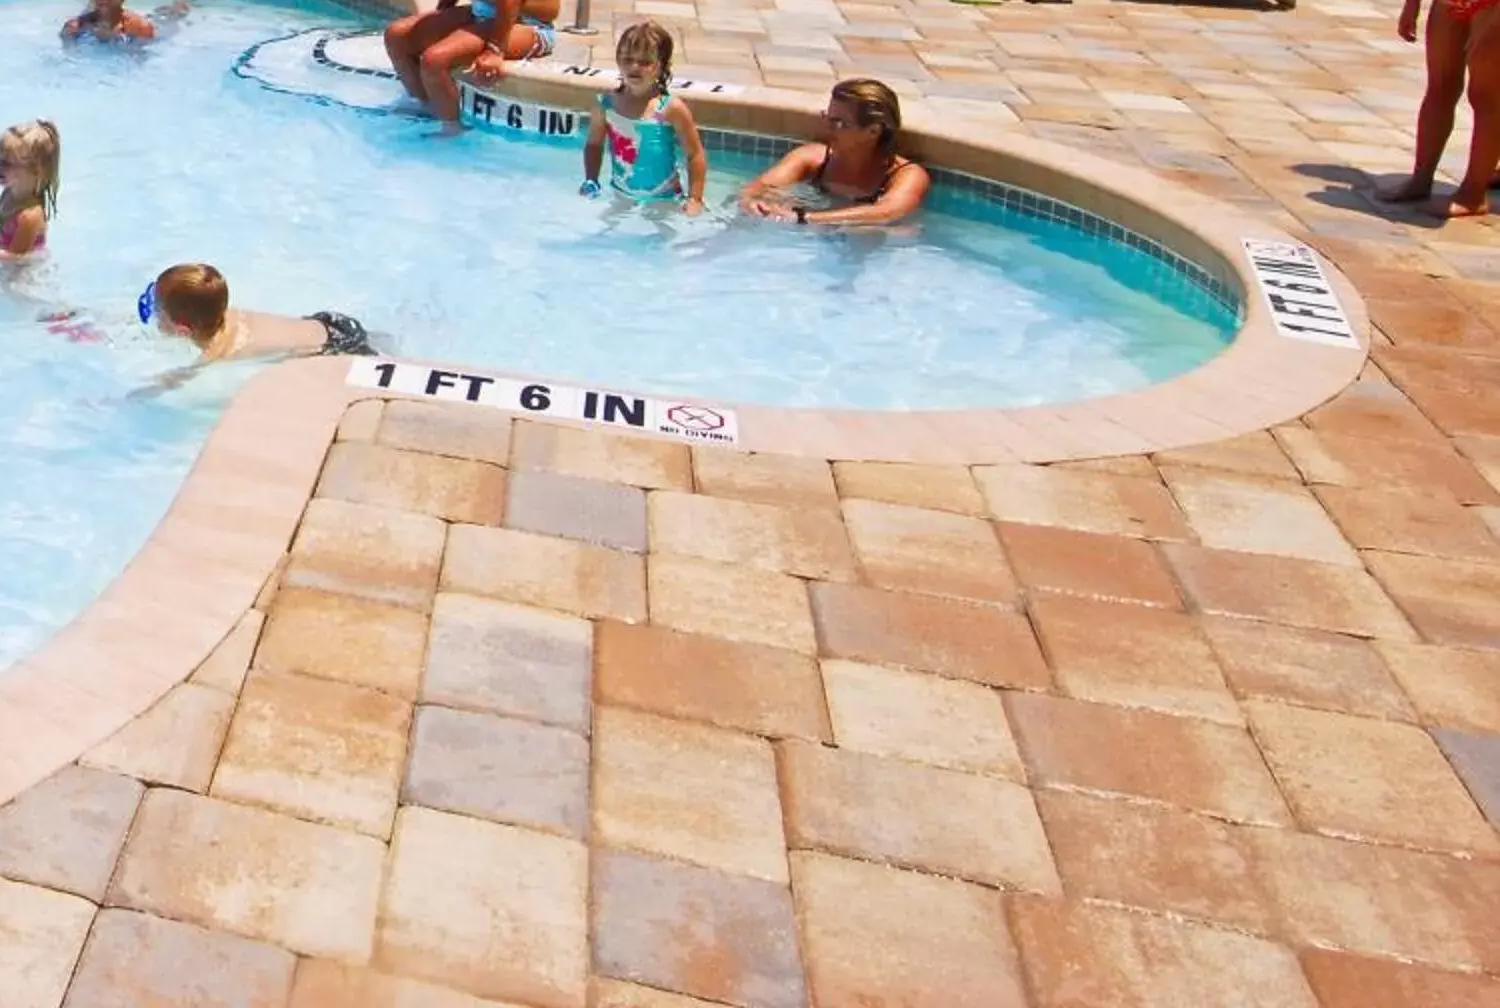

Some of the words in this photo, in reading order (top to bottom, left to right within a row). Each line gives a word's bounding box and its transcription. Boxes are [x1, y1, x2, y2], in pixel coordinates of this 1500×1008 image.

[473, 92, 496, 123] FT
[539, 110, 573, 134] IN
[1268, 293, 1344, 323] FT
[374, 363, 396, 387] 1
[425, 370, 494, 401] FT
[519, 385, 550, 411] 6
[583, 391, 645, 427] IN
